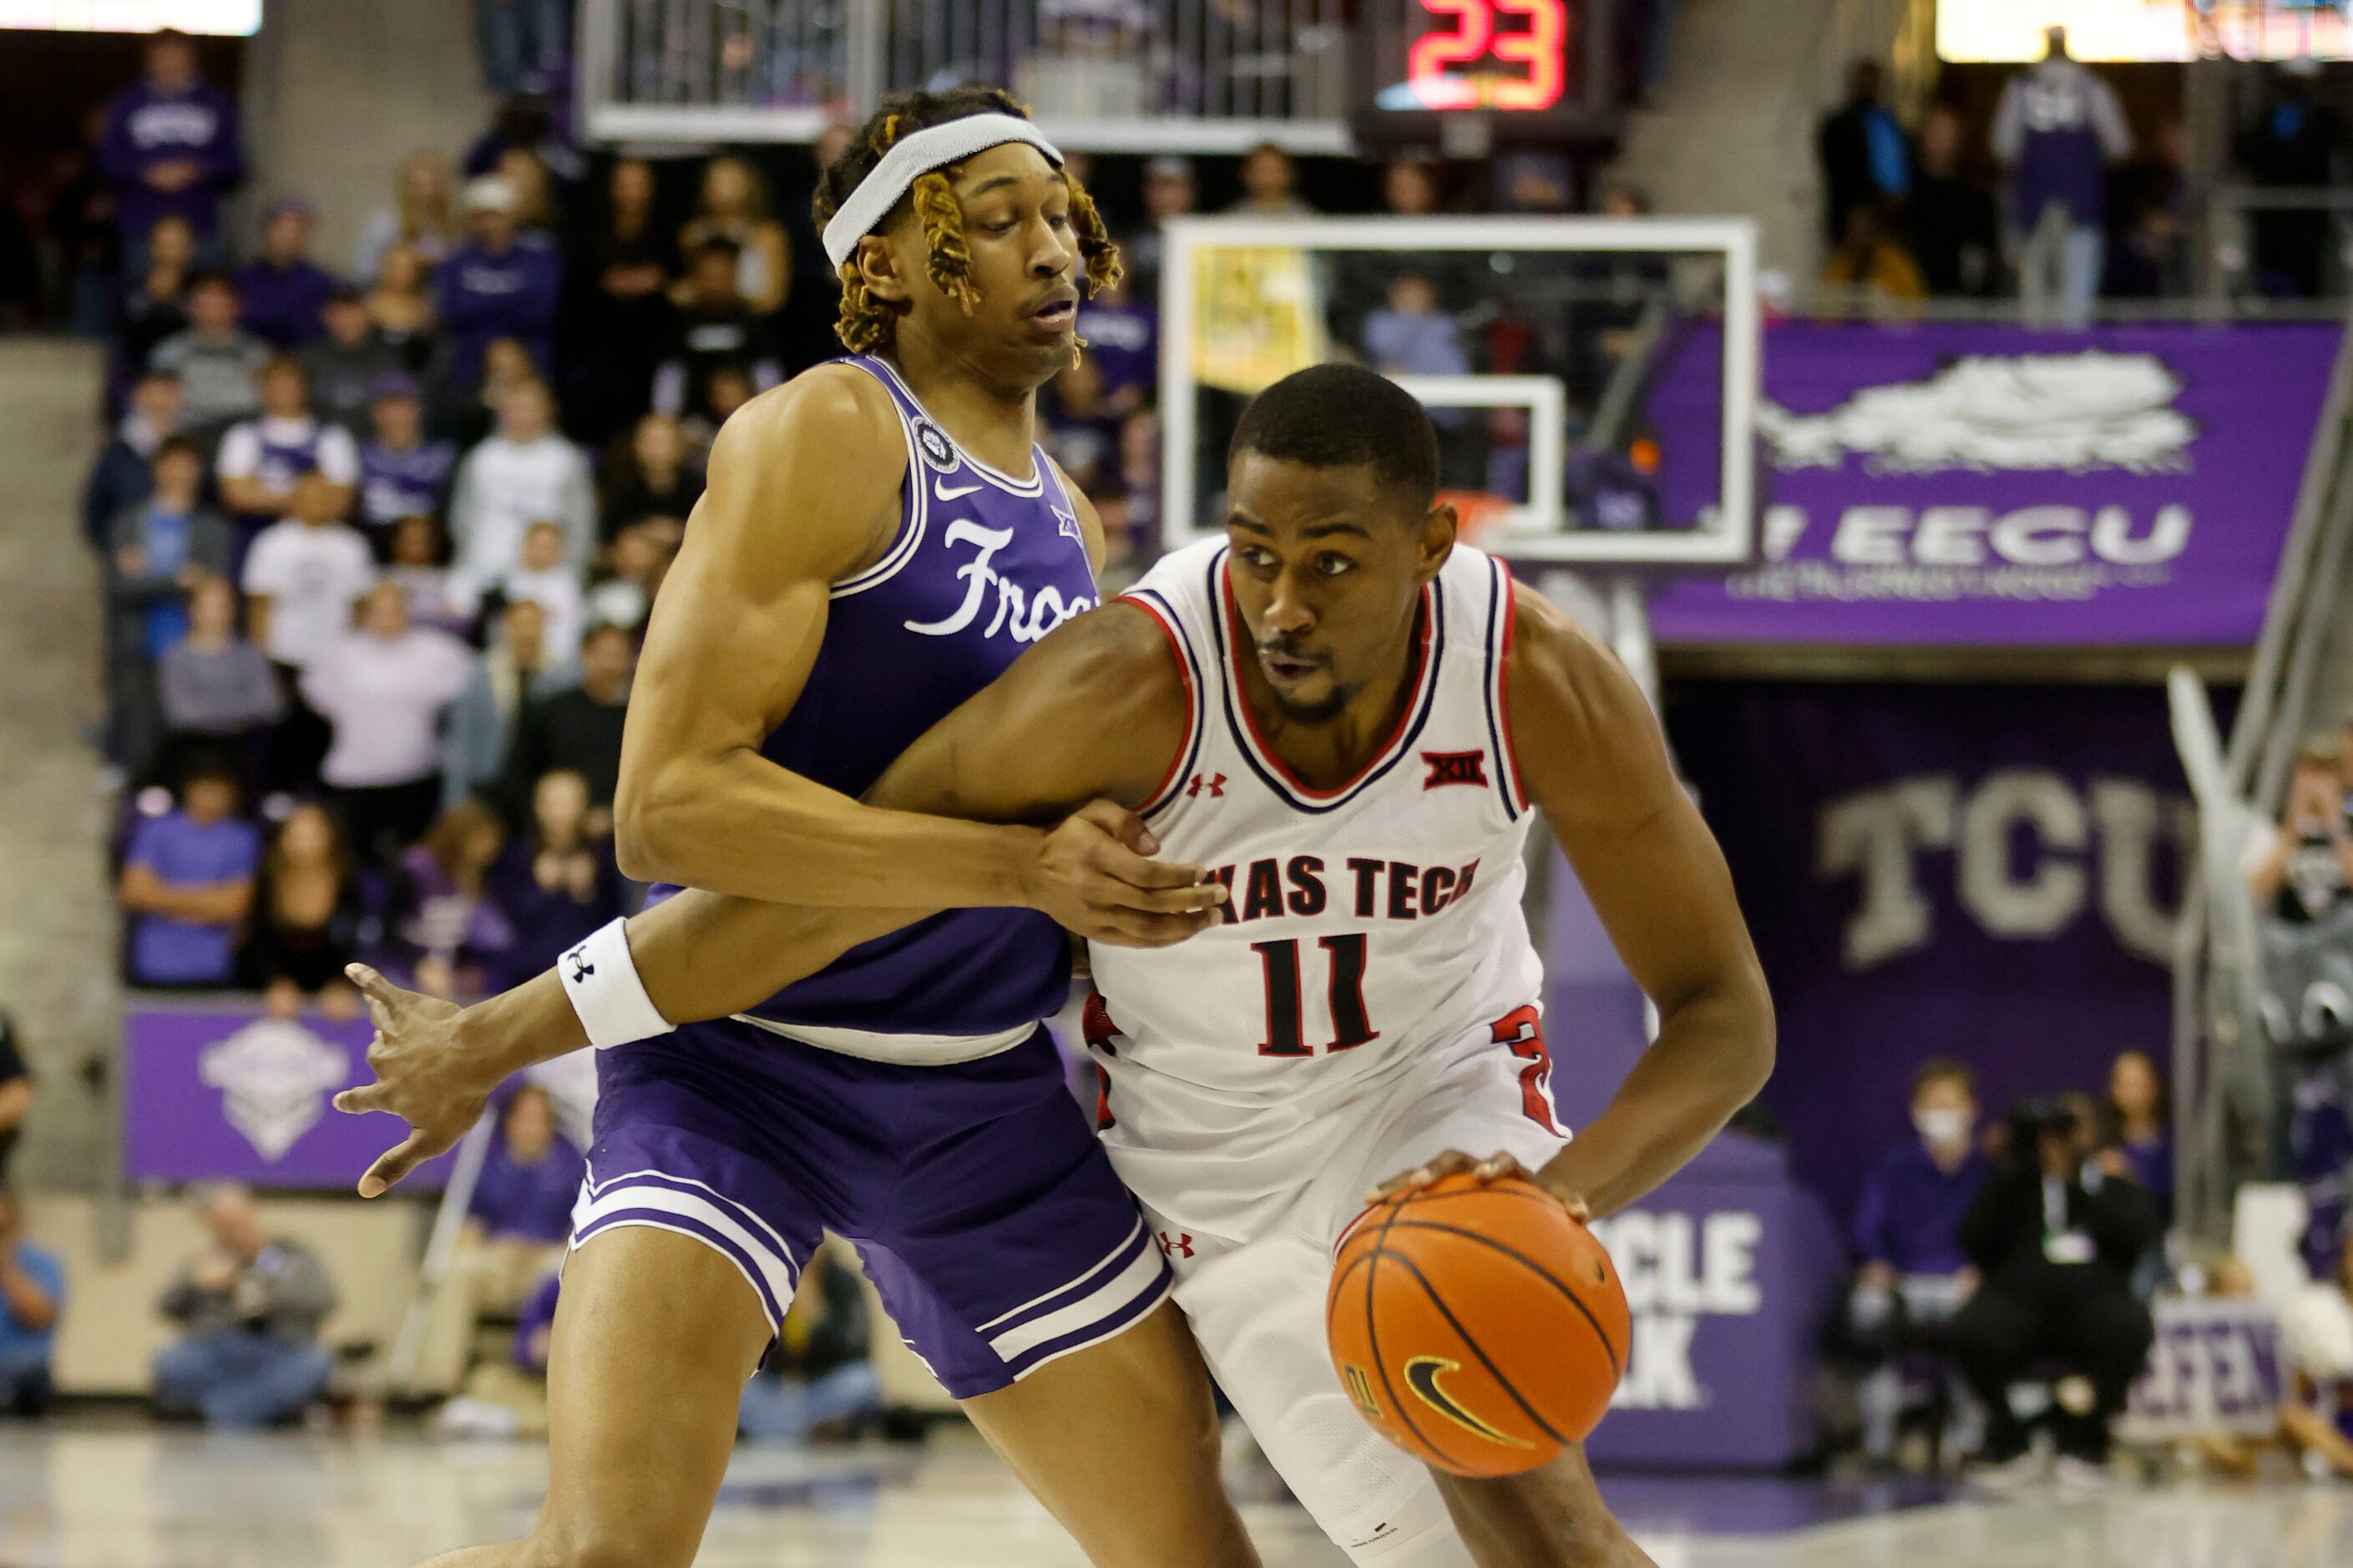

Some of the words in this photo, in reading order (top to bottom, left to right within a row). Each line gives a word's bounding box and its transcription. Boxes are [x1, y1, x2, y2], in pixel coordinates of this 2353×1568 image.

[1409, 0, 1566, 110] 23
[1833, 504, 2191, 566] EECU
[1816, 768, 2201, 973] TCU
[1251, 933, 1379, 1057] 11
